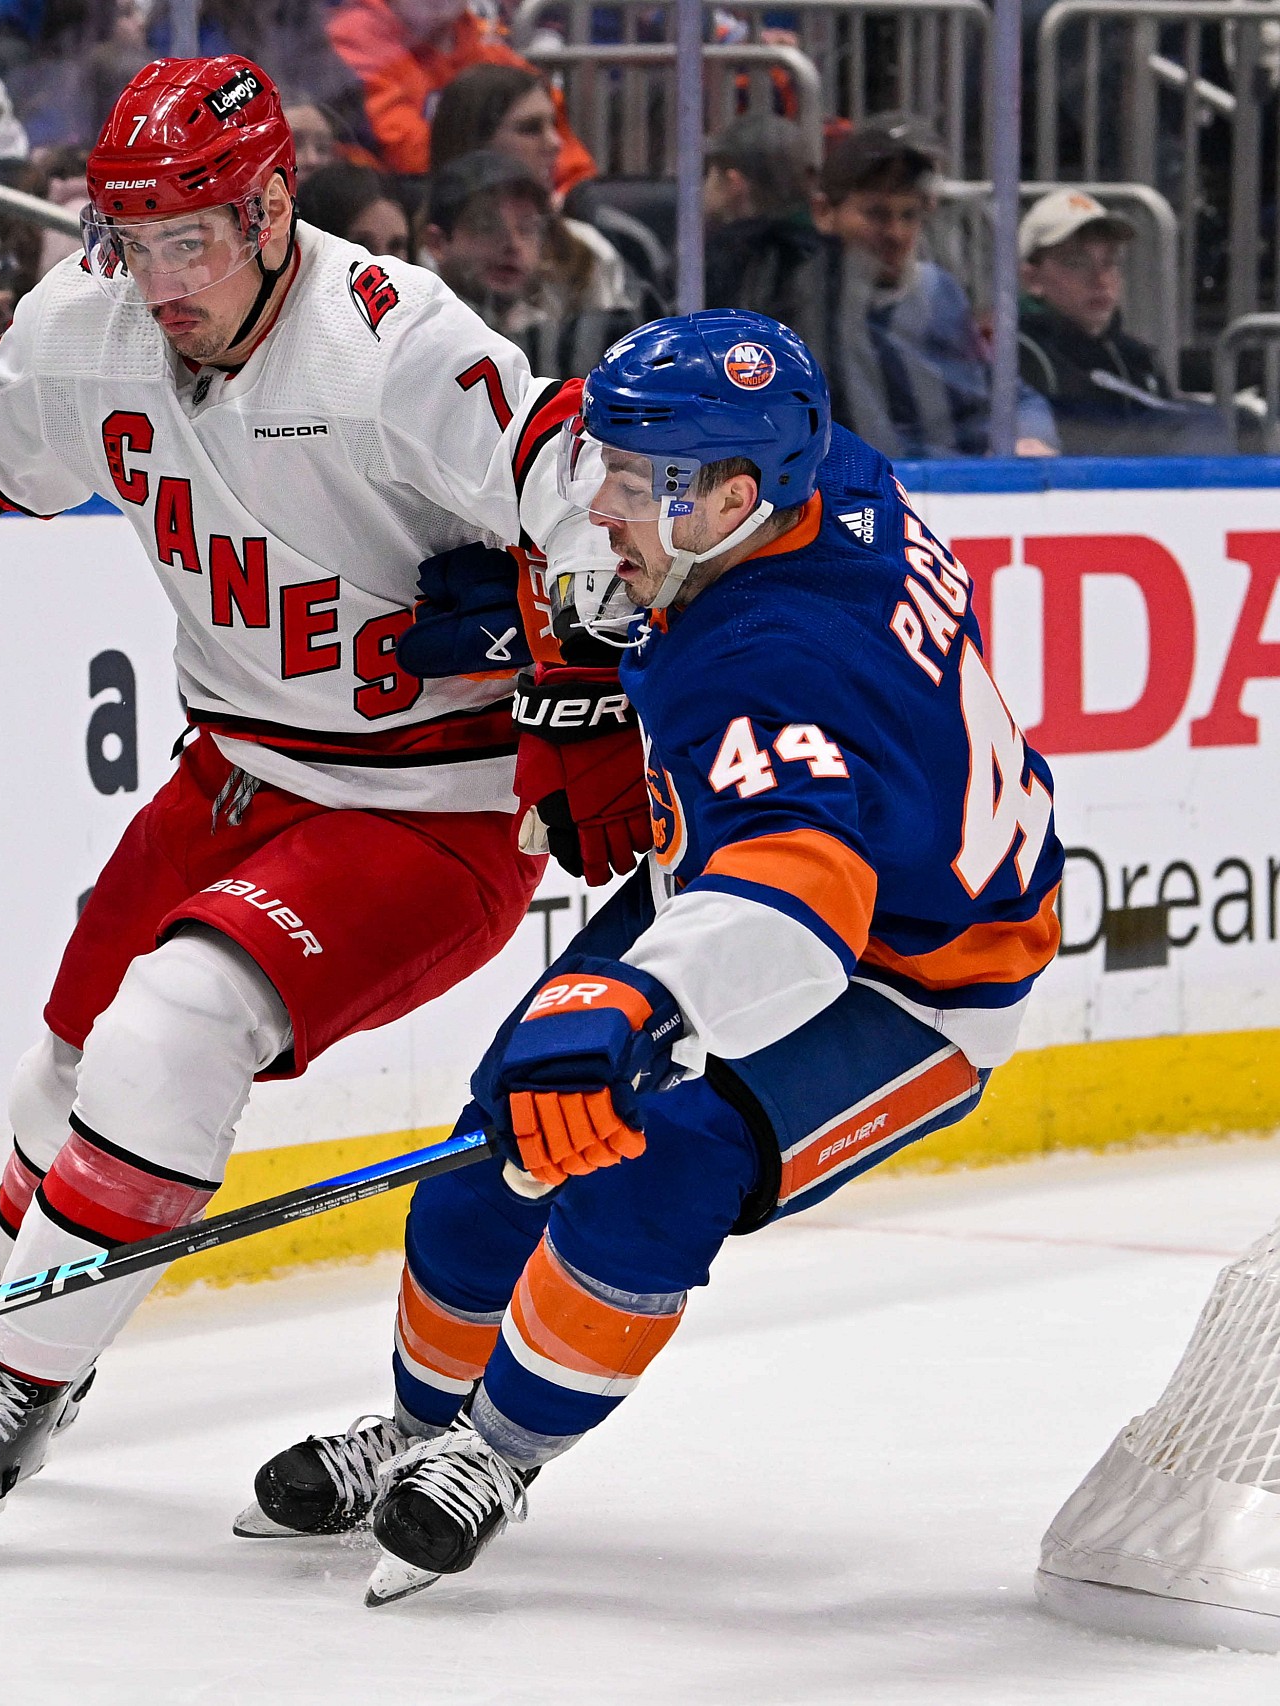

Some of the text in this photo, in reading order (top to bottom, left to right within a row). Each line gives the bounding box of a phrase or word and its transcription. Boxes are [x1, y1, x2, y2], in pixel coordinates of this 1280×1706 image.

[126, 115, 148, 147] 7
[105, 179, 157, 190] BAUER
[455, 356, 513, 433] 7
[254, 425, 328, 439] NUCOR
[863, 507, 875, 544] adidas
[101, 409, 426, 721] CANES
[888, 474, 971, 687] PAGE
[86, 649, 138, 796] a
[512, 689, 630, 728] UER
[707, 716, 850, 800] 44
[199, 878, 323, 958] BAUER
[651, 1012, 682, 1042] PAGEAU
[817, 1112, 889, 1166] BAUER
